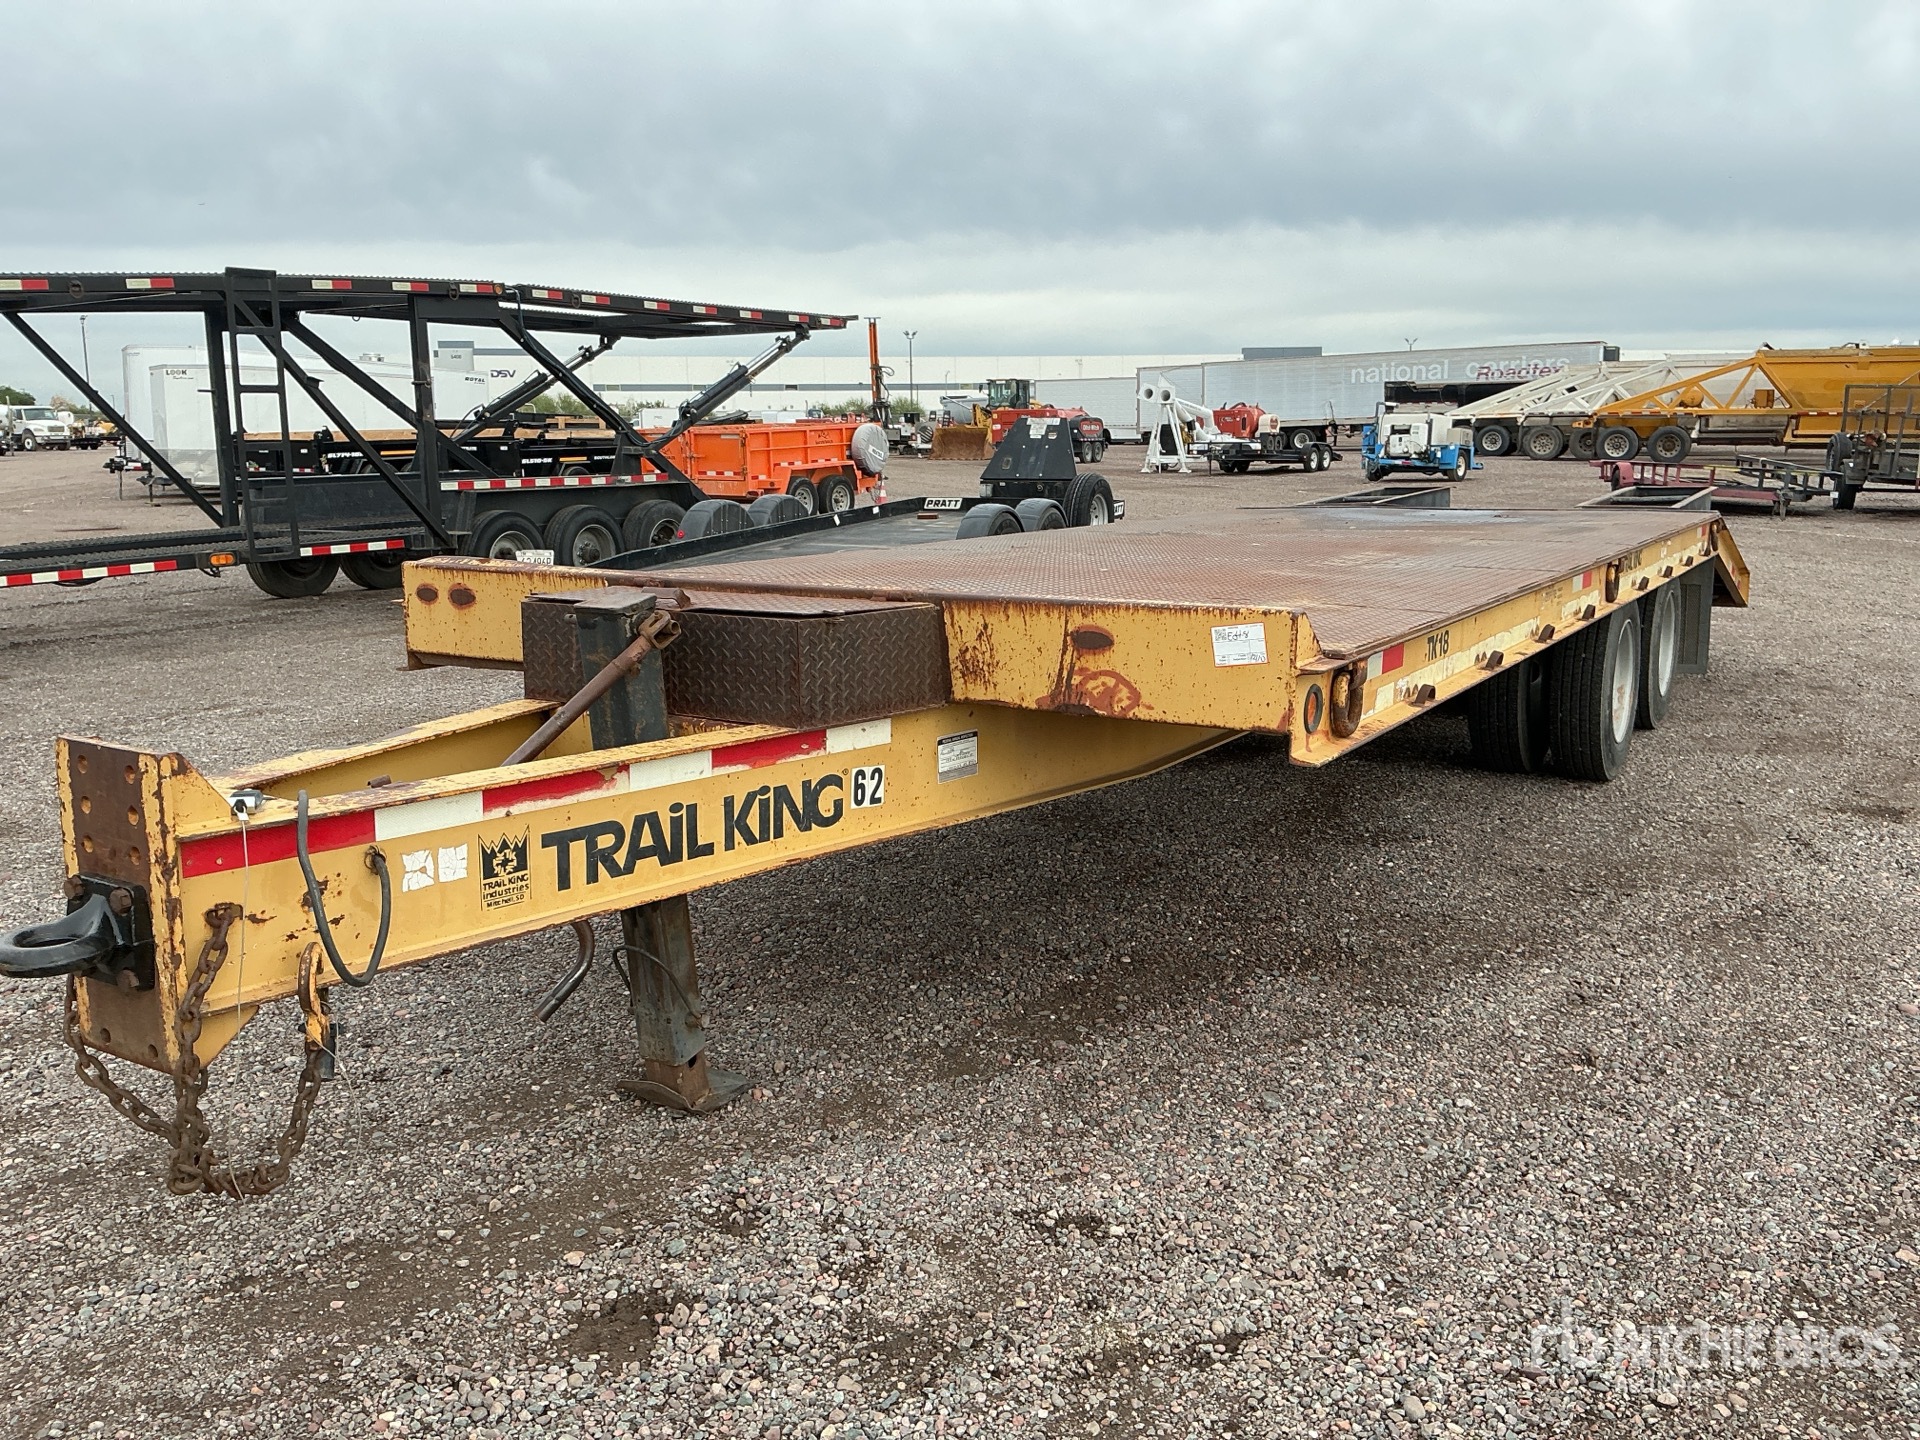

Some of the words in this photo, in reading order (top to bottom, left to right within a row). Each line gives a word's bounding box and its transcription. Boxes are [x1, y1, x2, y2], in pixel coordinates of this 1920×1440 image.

[490, 369, 516, 378] DSV
[1351, 360, 1449, 384] national
[926, 499, 961, 508] PRATT
[1113, 504, 1124, 513] ATT
[852, 767, 884, 808] 62
[482, 883, 530, 900] industries
